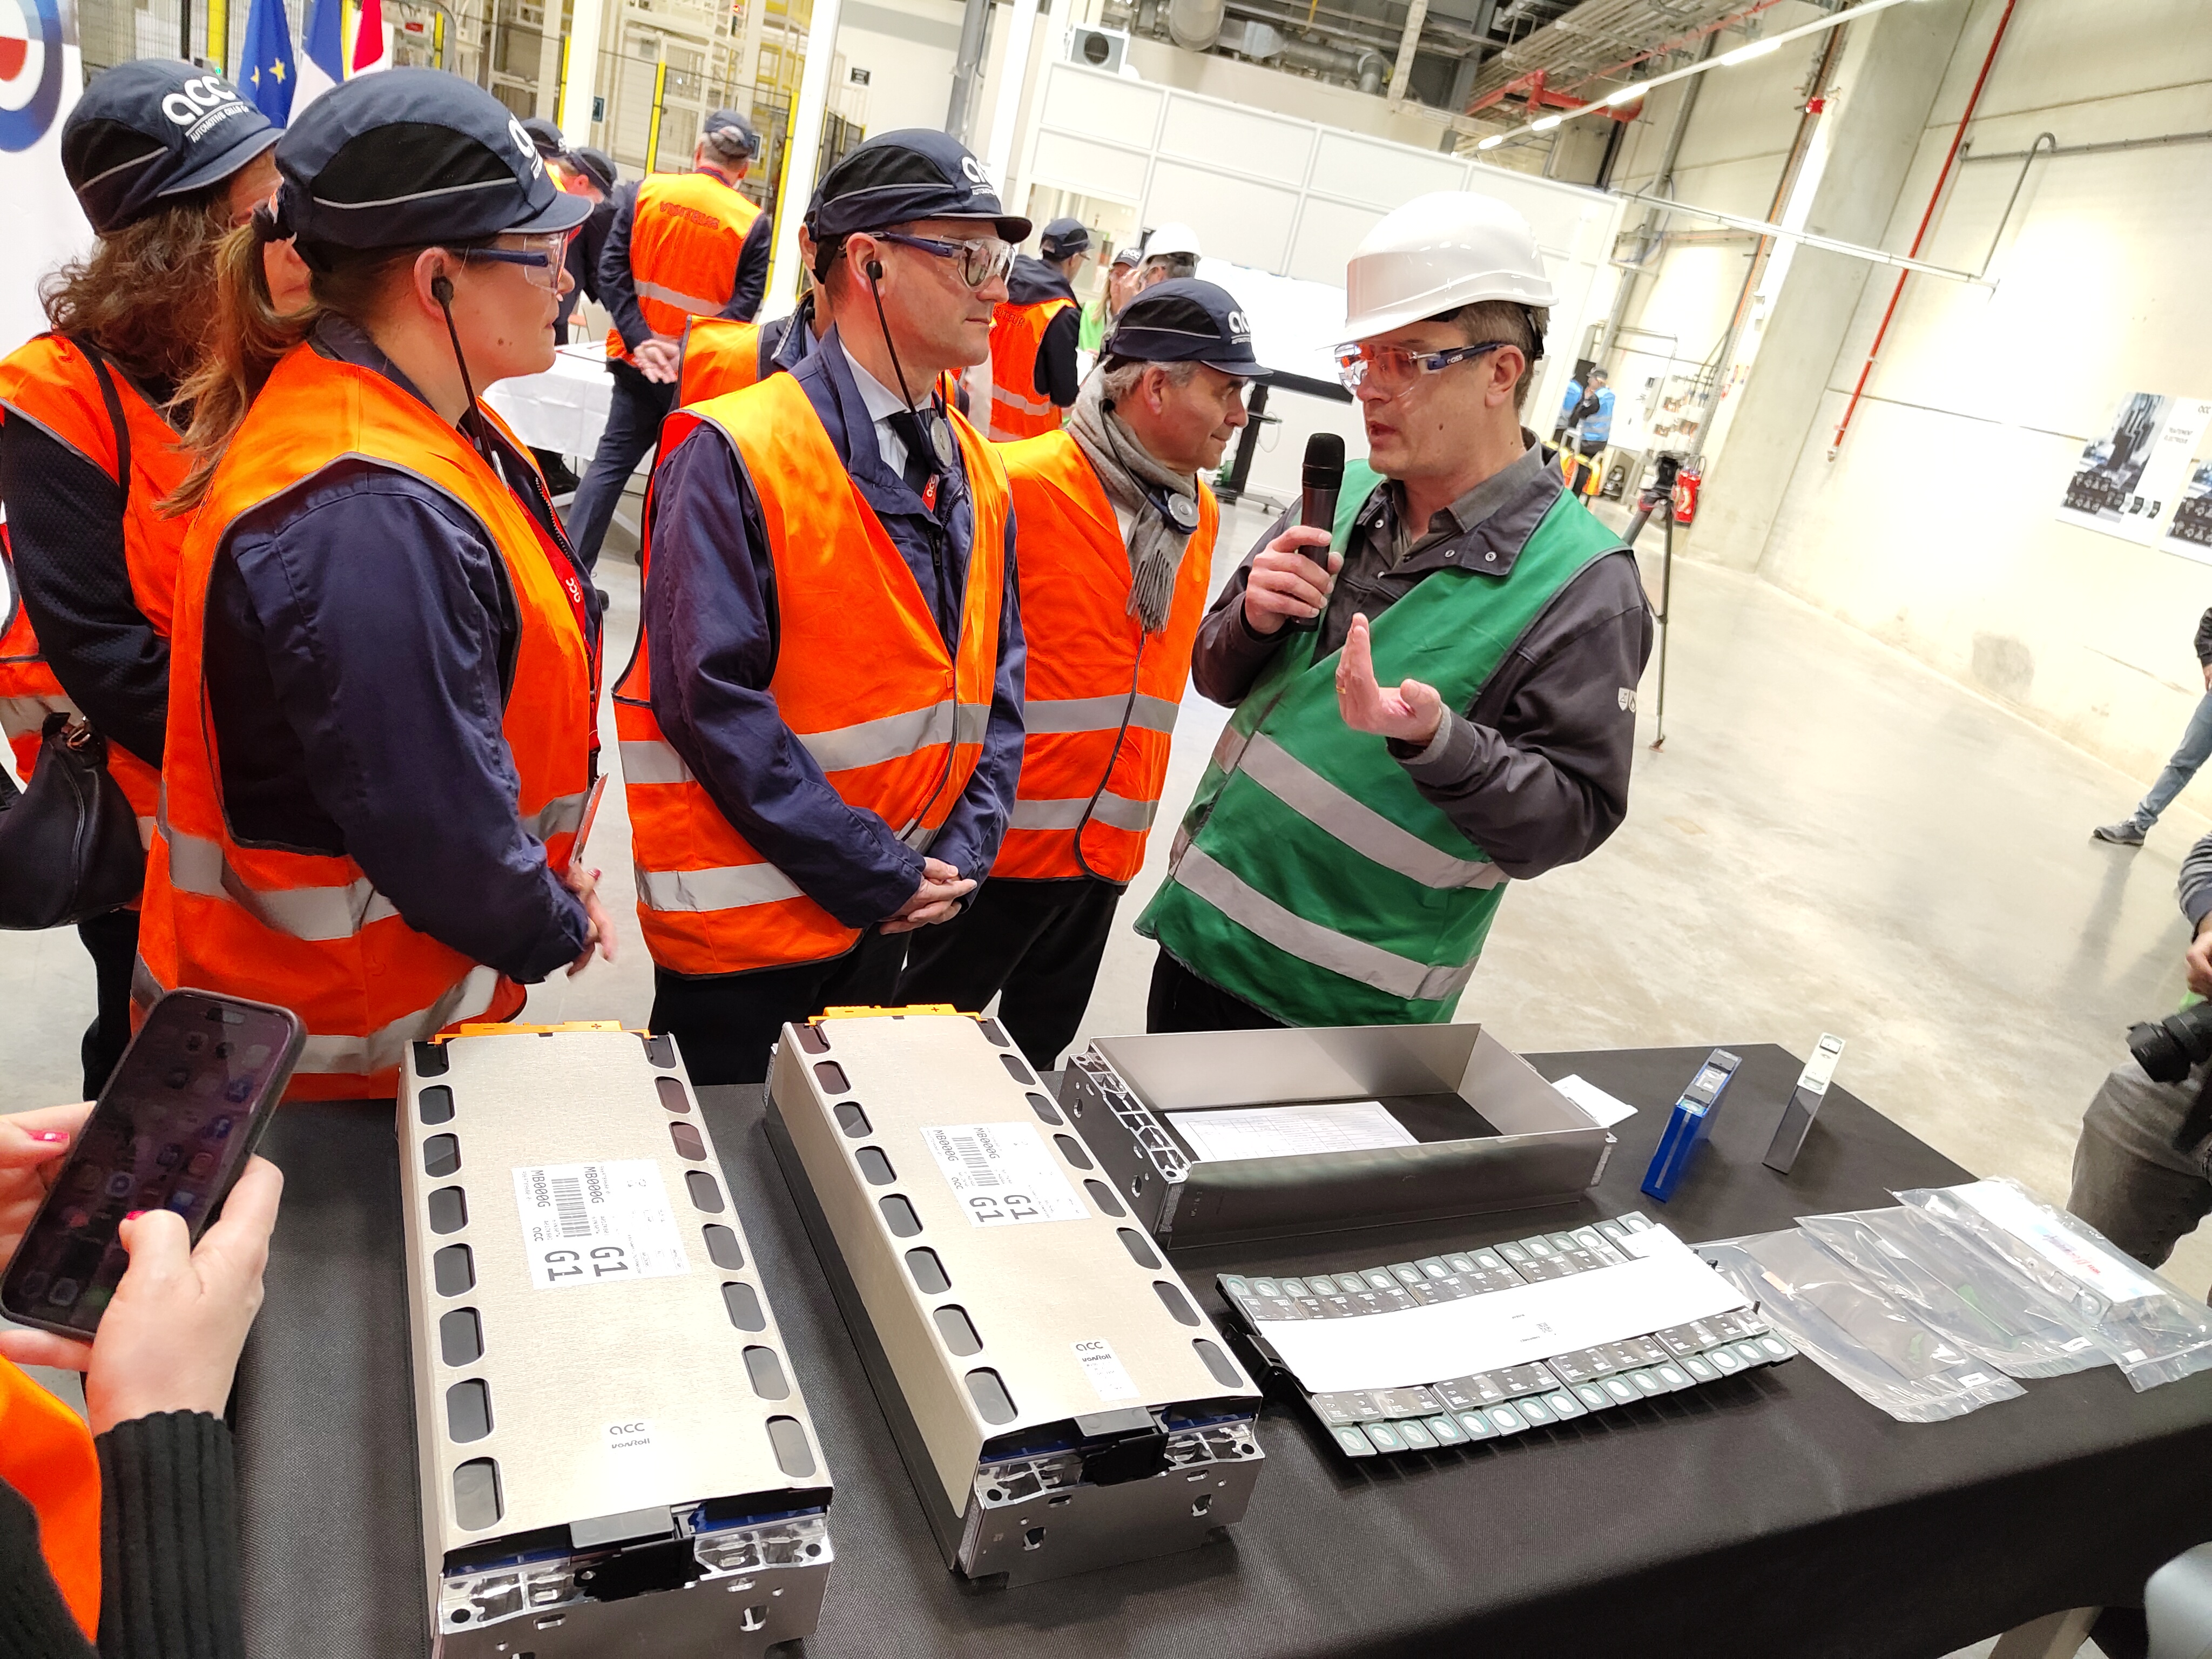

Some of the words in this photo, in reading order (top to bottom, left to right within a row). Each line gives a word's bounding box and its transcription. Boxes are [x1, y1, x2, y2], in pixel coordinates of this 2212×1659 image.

[162, 76, 237, 126] acc
[190, 111, 226, 143] AUTOMOTIVE
[926, 476, 935, 497] acc
[565, 577, 581, 603] acc
[933, 1130, 959, 1161] MB000G
[973, 1128, 1000, 1159] MB000G
[530, 1170, 551, 1208] MB000G
[583, 1166, 605, 1204] MB000G
[951, 1177, 964, 1190] acc
[969, 1197, 1005, 1223] G1
[1003, 1195, 1039, 1220] G1
[532, 1226, 544, 1242] acc
[544, 1250, 583, 1282] G1
[590, 1246, 629, 1277] G1
[1075, 1341, 1104, 1351] acc
[1082, 1353, 1112, 1362] vonRoll
[609, 1422, 645, 1435] acc
[611, 1438, 650, 1449] vonRoll
